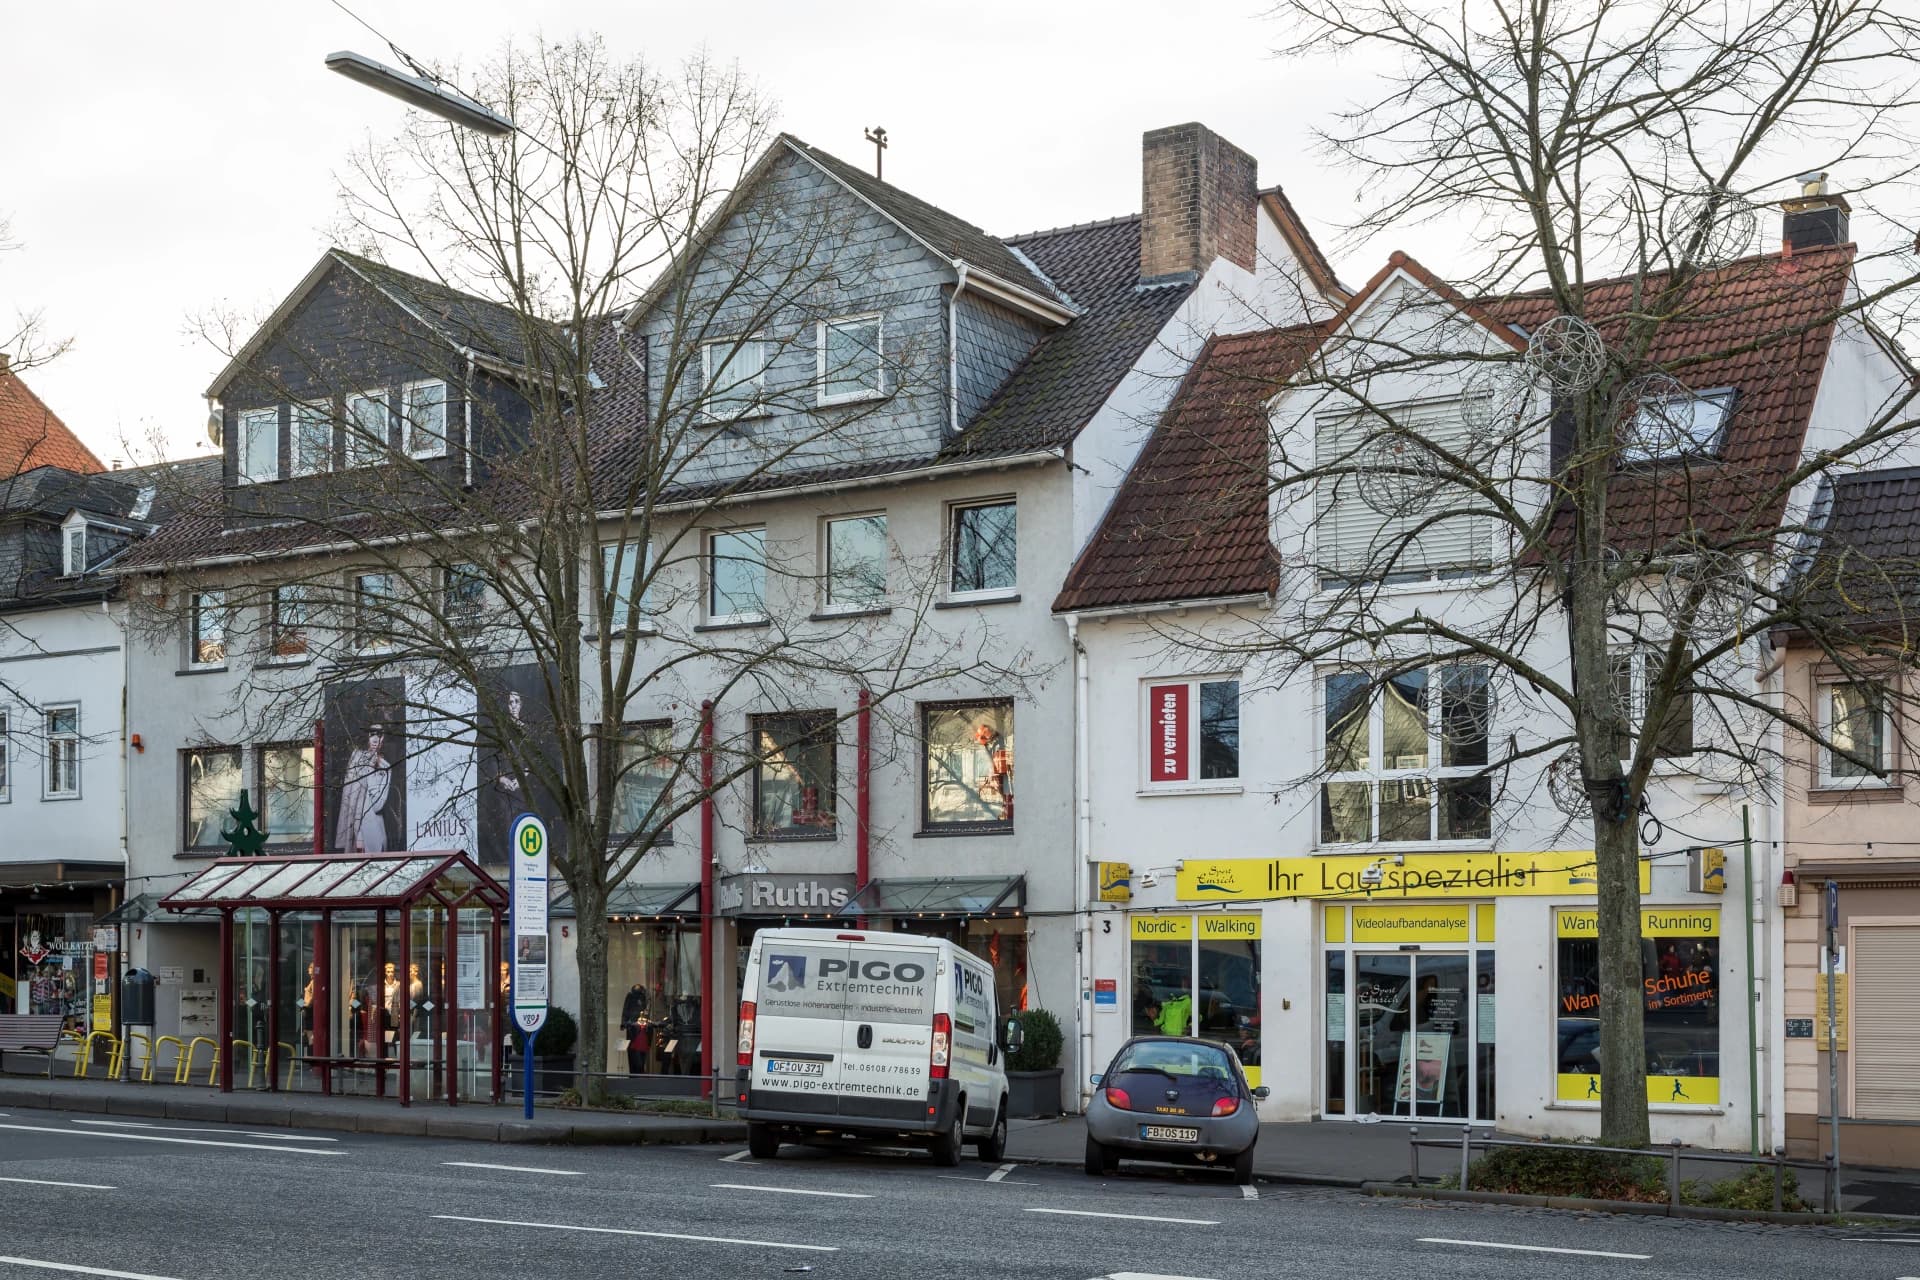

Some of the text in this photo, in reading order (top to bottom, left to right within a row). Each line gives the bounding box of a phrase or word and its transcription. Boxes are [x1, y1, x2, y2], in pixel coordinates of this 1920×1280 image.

[1159, 693, 1177, 774] zu vermieten
[416, 818, 467, 838] LANIUS
[525, 831, 537, 850] H
[1268, 860, 1304, 891] Ihr
[752, 881, 849, 907] Ruths
[561, 925, 569, 937] 5
[1102, 920, 1111, 934] 3
[1137, 920, 1177, 933] Nordic
[1205, 919, 1255, 935] Walking
[1356, 917, 1467, 930] Videolaufbandanalyse
[1562, 915, 1712, 931] Wan Running
[818, 958, 925, 983] PIGO
[817, 980, 924, 997] Extremtechnik
[964, 968, 983, 996] PIGO
[1563, 970, 1711, 1013] Wan Schuhe
[1663, 989, 1713, 1008] Sortiment
[773, 1061, 822, 1074] OF OV 371
[843, 1062, 858, 1072] Tel.
[761, 1077, 920, 1096] www.pigo-extremtechnik.de
[1147, 1127, 1196, 1139] FB OS 119
